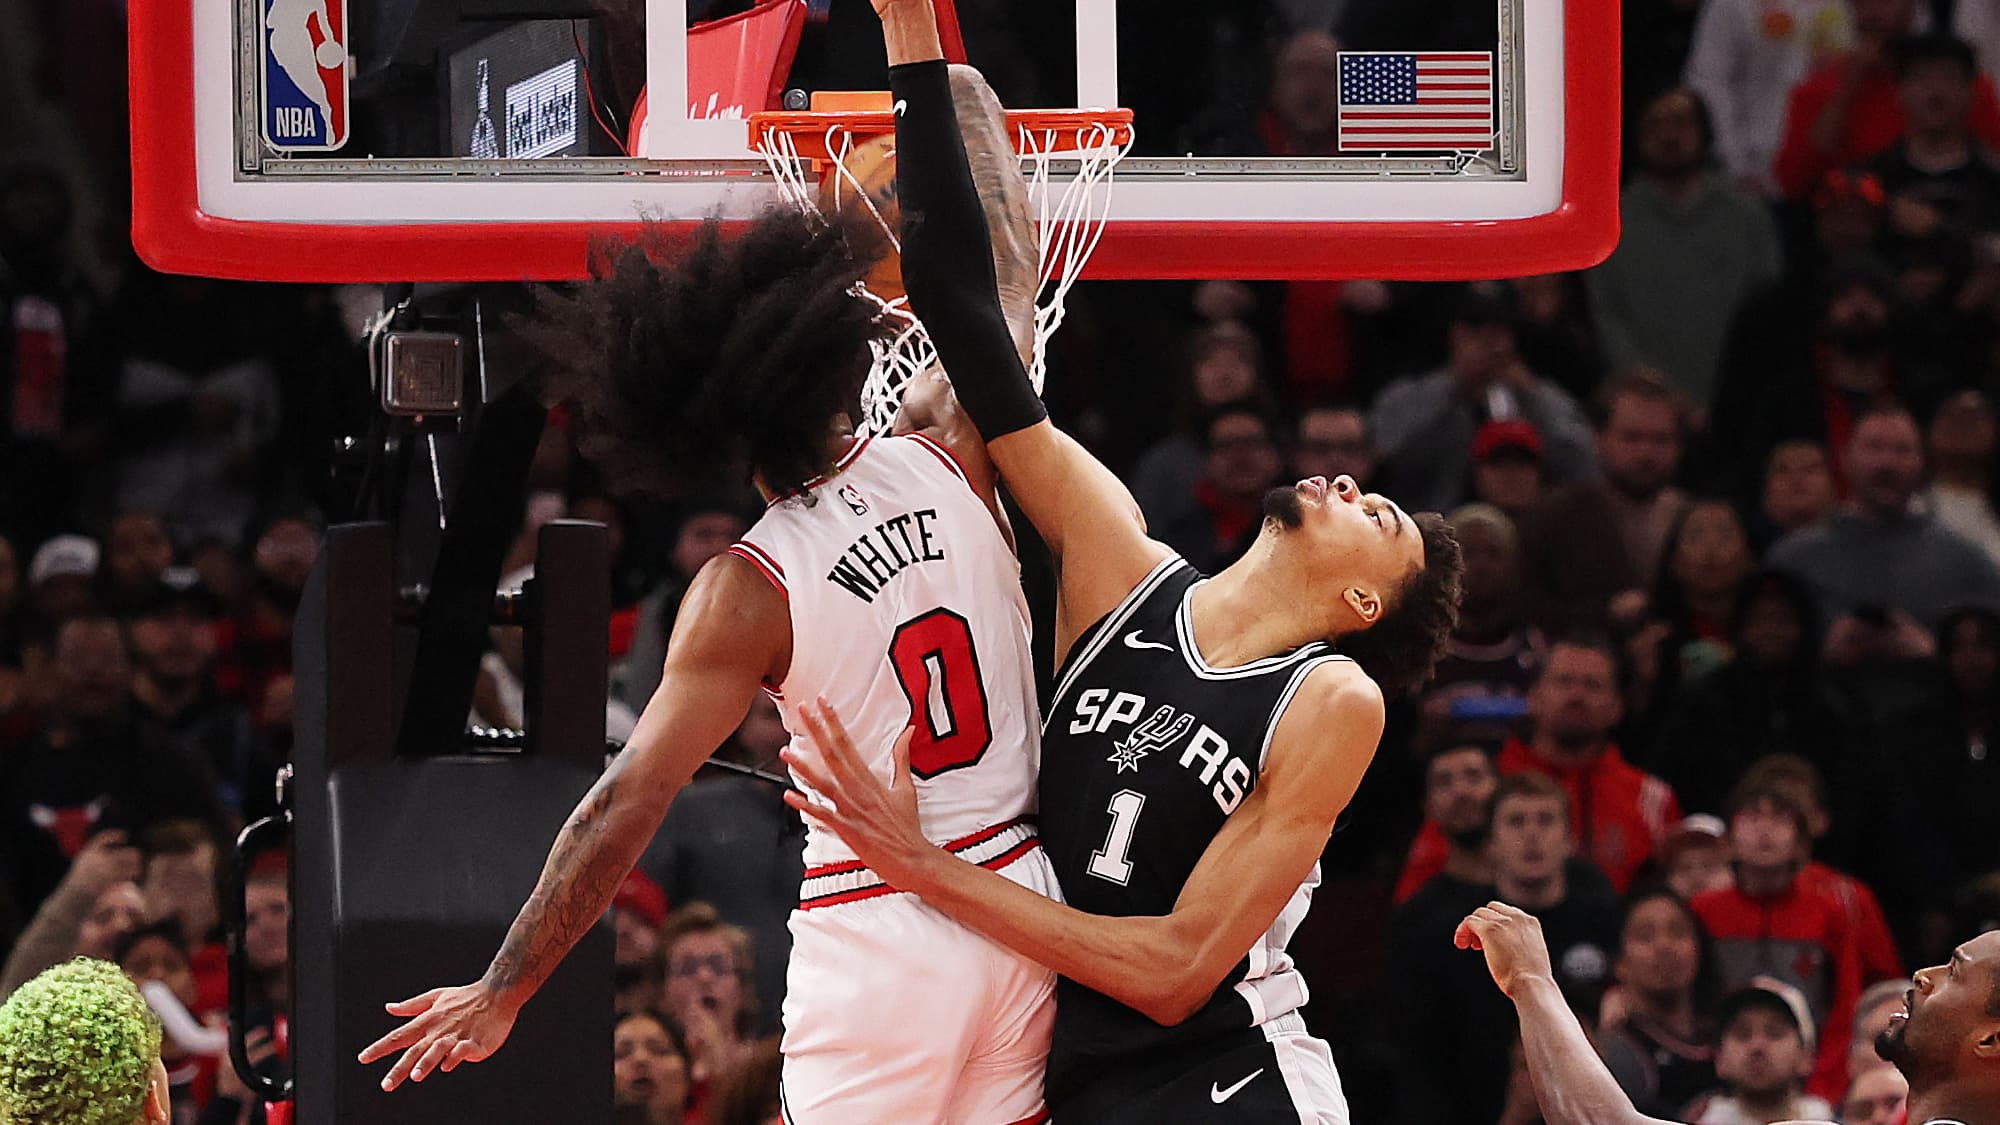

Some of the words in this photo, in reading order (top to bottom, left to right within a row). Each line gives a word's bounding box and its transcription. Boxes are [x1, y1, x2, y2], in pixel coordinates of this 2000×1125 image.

[276, 107, 316, 137] NBA
[826, 508, 945, 604] WHITE
[888, 606, 993, 781] 0
[1069, 688, 1251, 816] SPURS
[1086, 788, 1147, 887] 1
